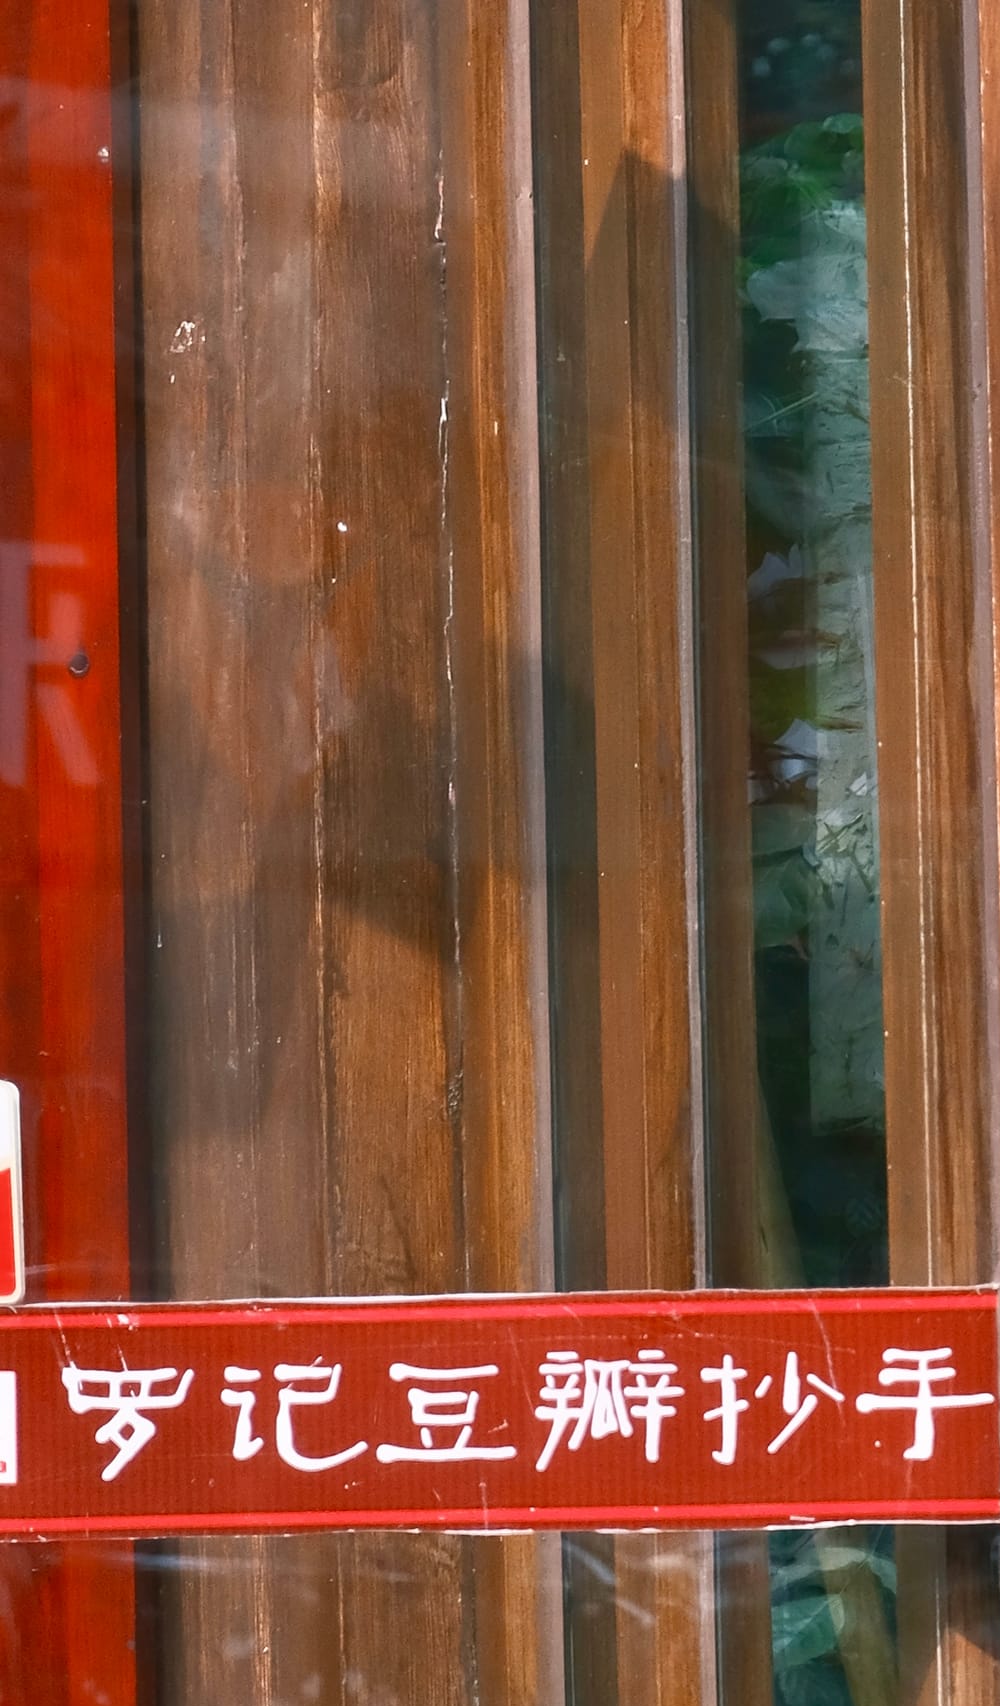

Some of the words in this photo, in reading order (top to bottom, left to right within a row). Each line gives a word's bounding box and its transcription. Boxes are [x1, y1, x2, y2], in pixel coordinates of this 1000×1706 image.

[61, 1346, 996, 1483] 罗记豆瓣抄手
